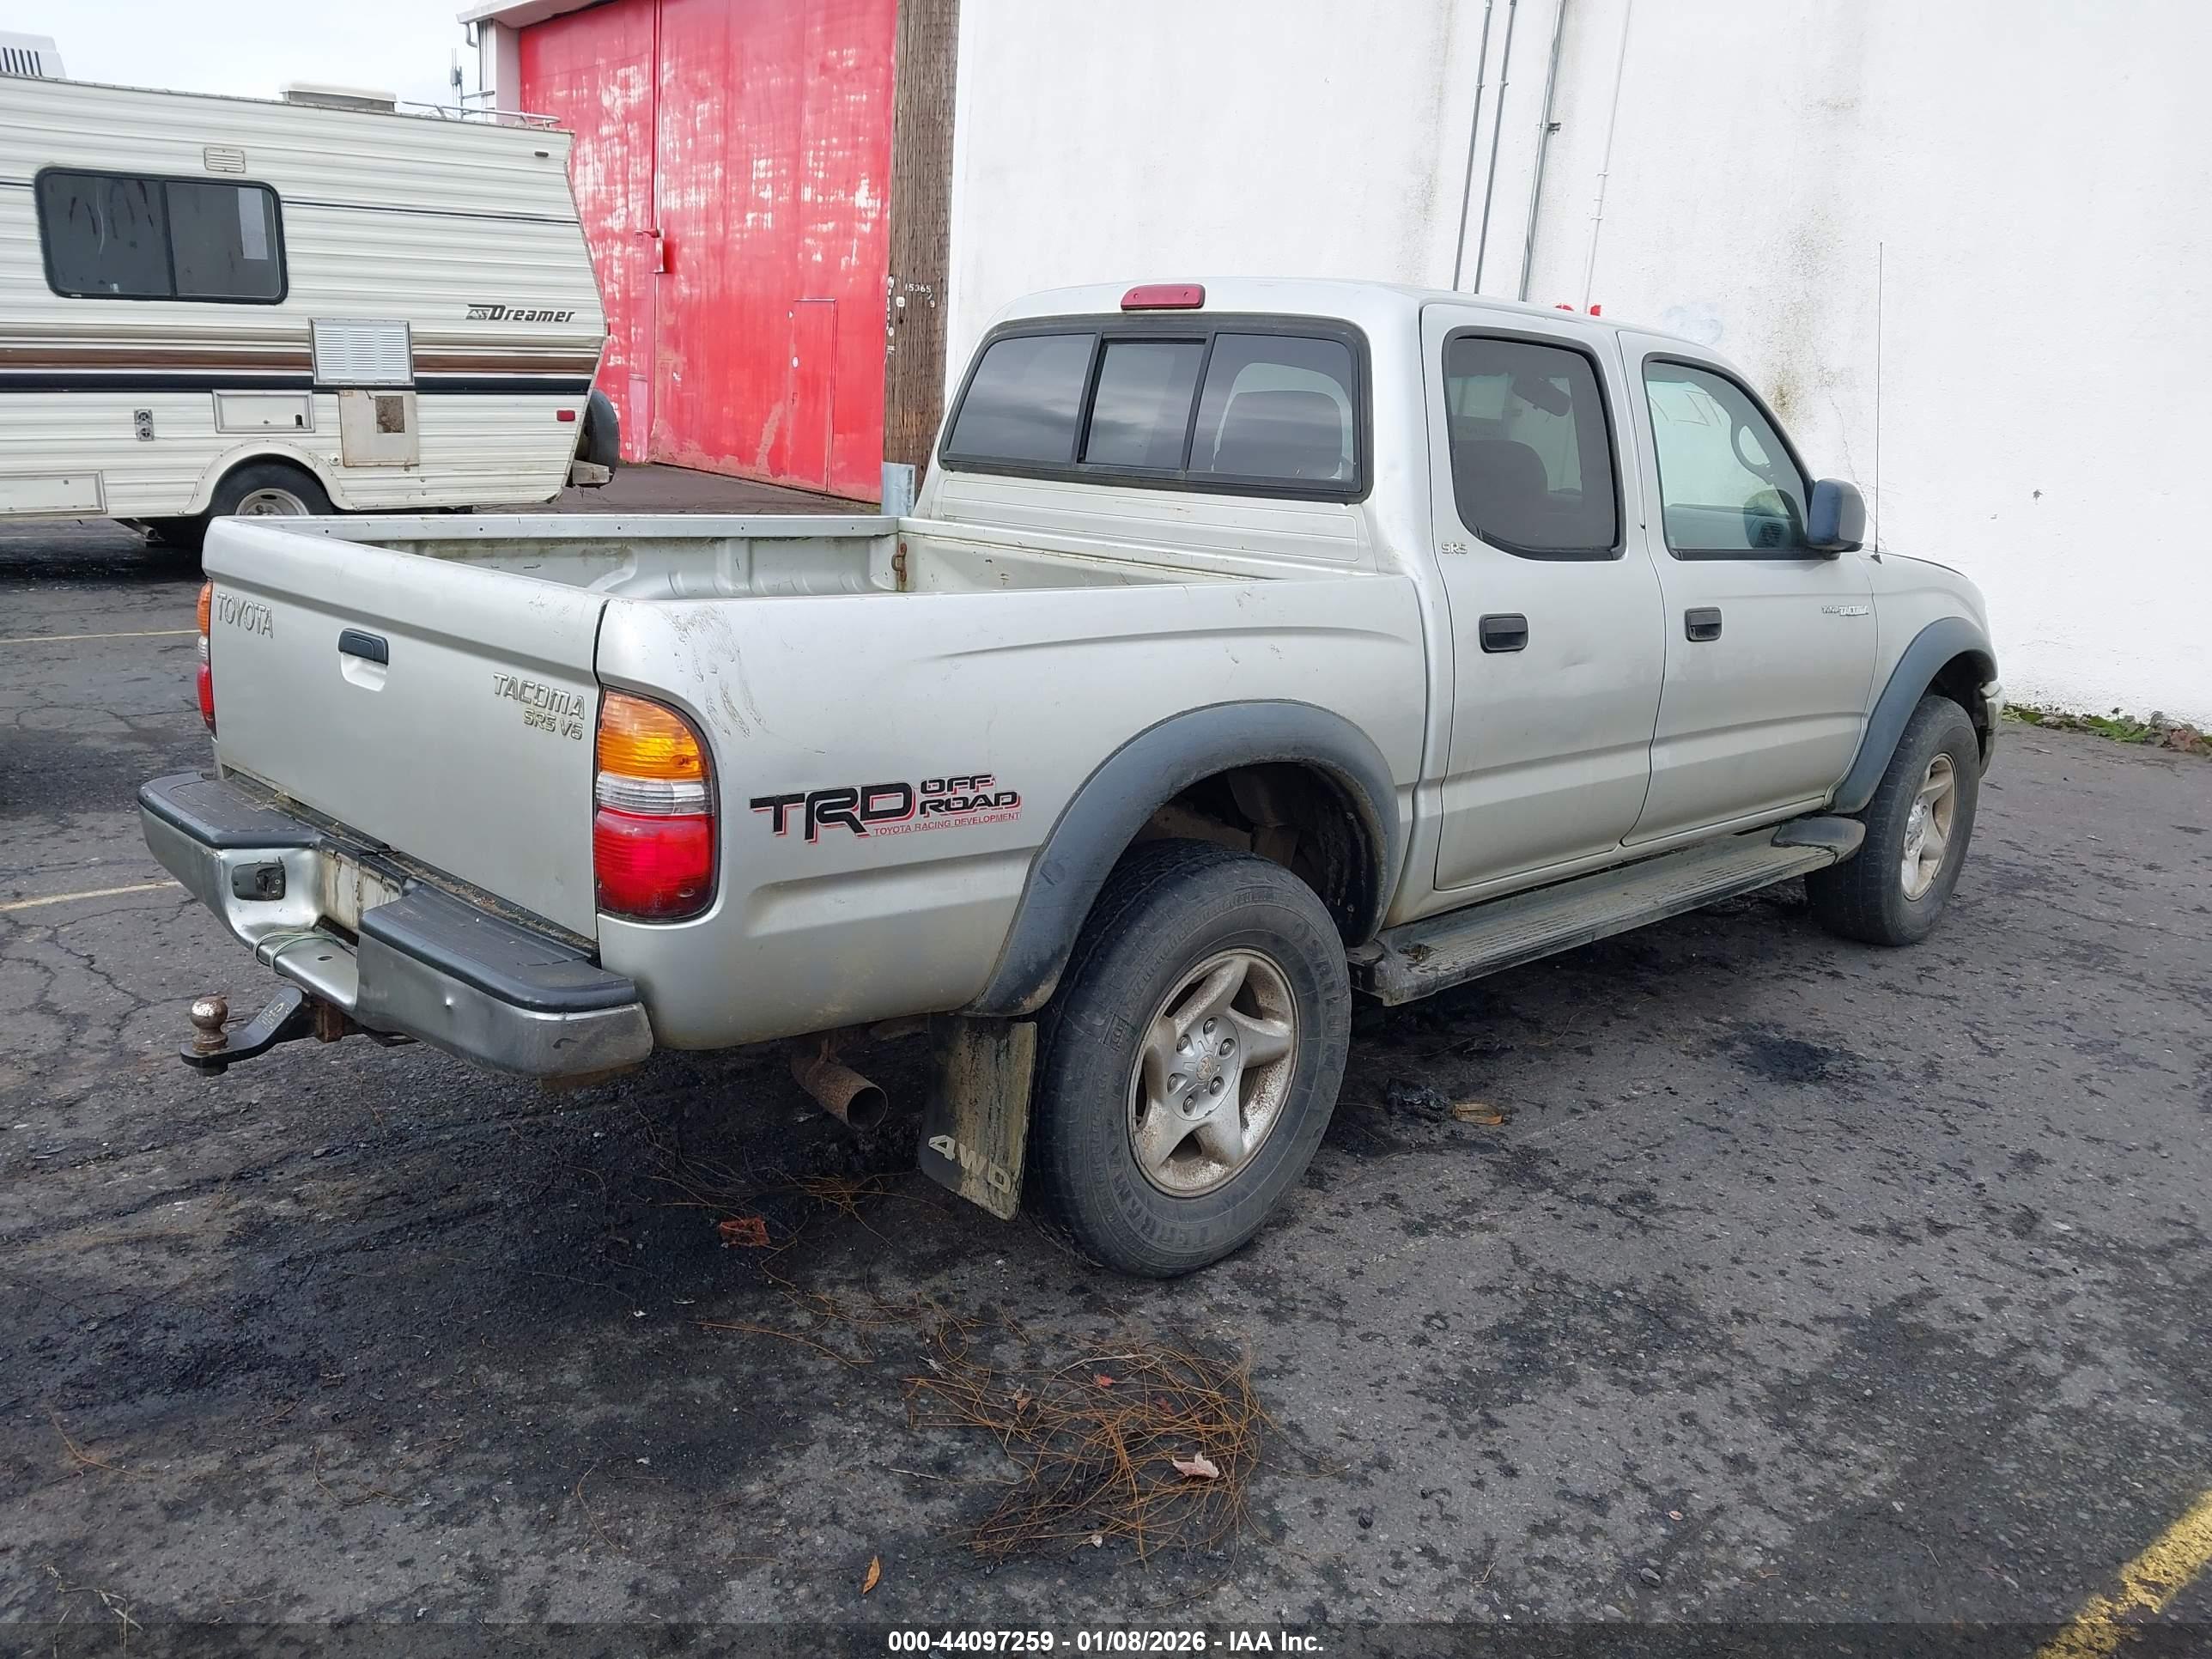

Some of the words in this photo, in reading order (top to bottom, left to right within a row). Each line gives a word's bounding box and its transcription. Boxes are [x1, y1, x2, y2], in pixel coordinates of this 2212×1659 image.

[468, 304, 575, 323] Dreamer
[216, 592, 274, 639] TOYOTA
[493, 672, 585, 720] TACOMA
[524, 708, 556, 732] SR5
[560, 718, 583, 740] V6
[921, 773, 995, 796] OFF
[750, 782, 916, 844] TRD
[920, 791, 1021, 817] ROAD
[874, 824, 912, 836] TOYOTA
[915, 820, 951, 831] RACING
[954, 812, 1021, 827] DEVELOPMENT
[927, 1134, 1012, 1194] 4WD
